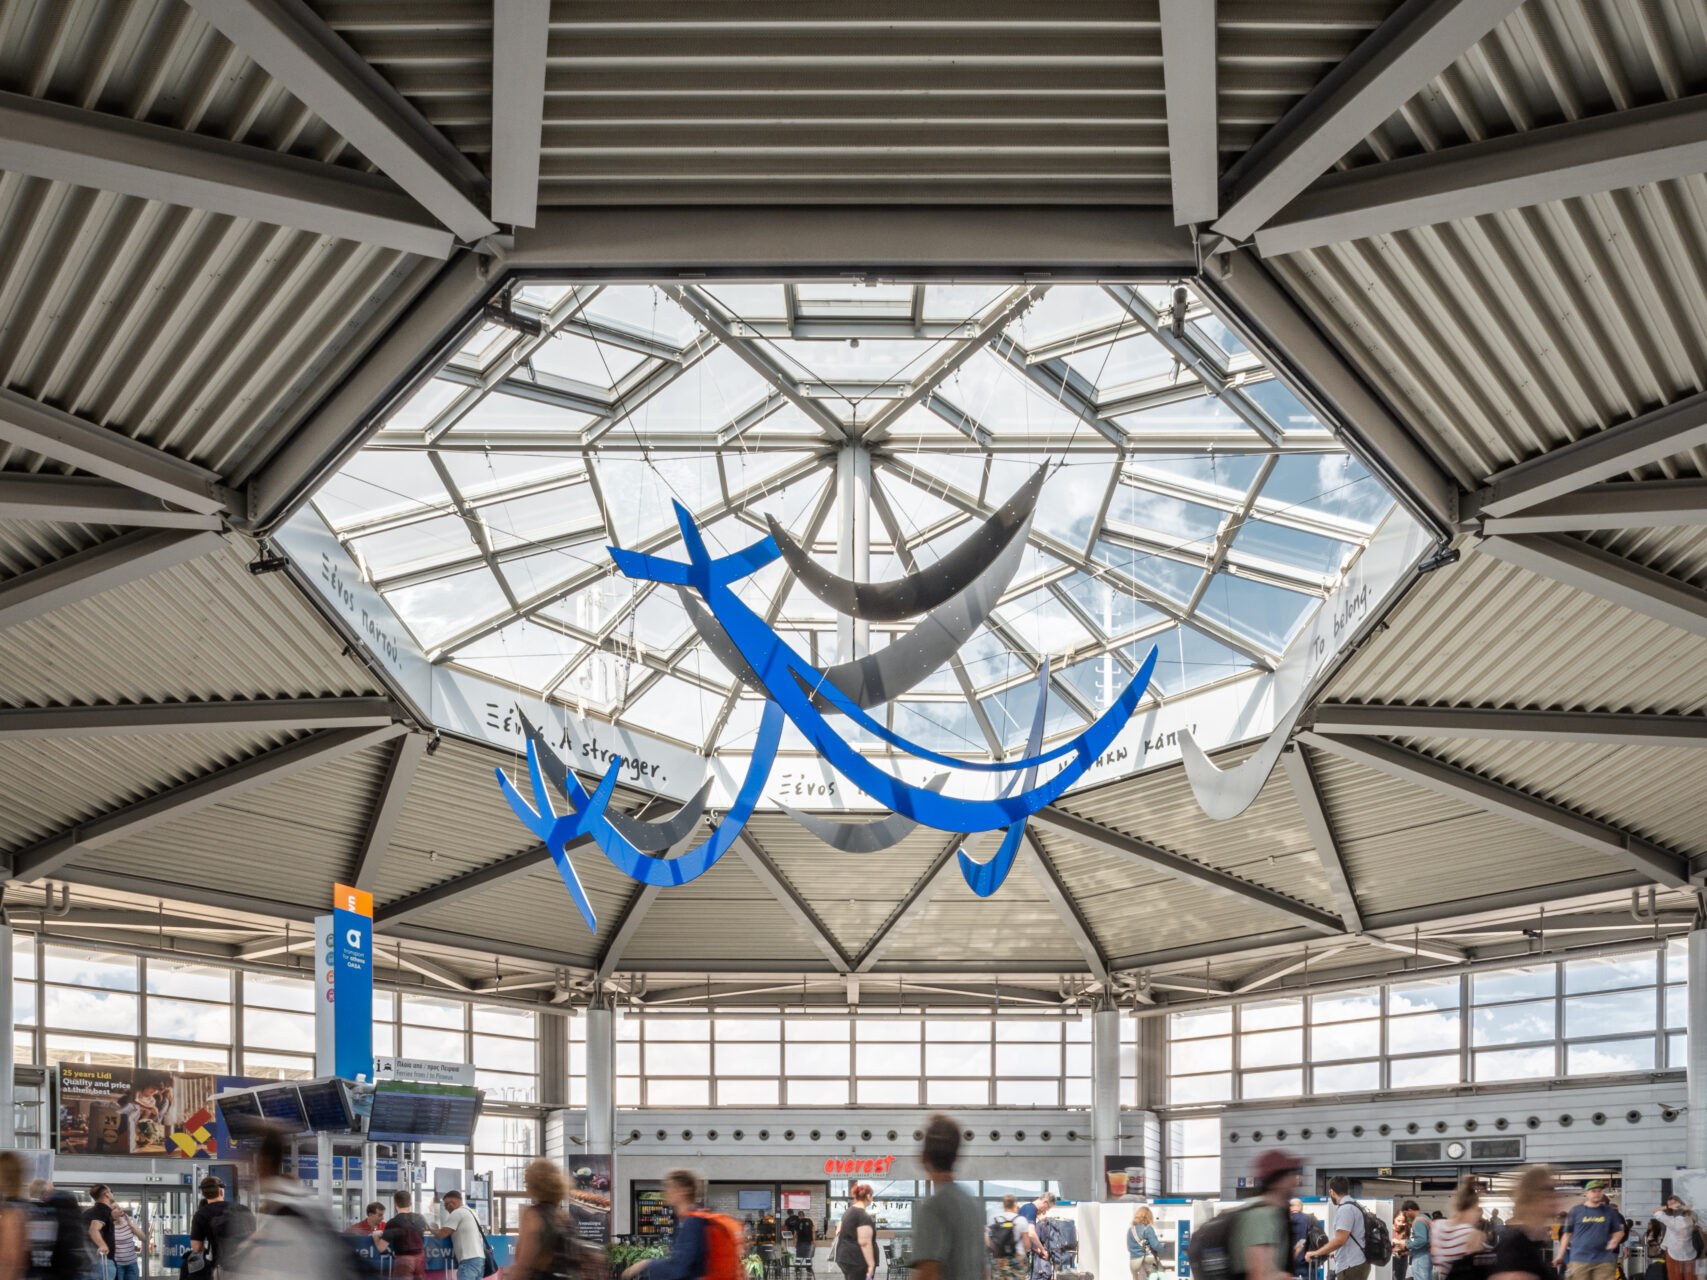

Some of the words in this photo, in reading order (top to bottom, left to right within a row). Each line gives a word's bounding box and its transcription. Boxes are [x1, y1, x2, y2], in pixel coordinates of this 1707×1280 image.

[1313, 634, 1325, 661] To
[1333, 583, 1372, 637] belong.
[779, 773, 835, 796] Ξένος
[63, 1069, 73, 1077] 25
[62, 1077, 93, 1087] Quality
[94, 1080, 110, 1088] and
[111, 1081, 131, 1090] price
[72, 1086, 92, 1094] their
[93, 1087, 110, 1096] best
[824, 1154, 897, 1174] everest
